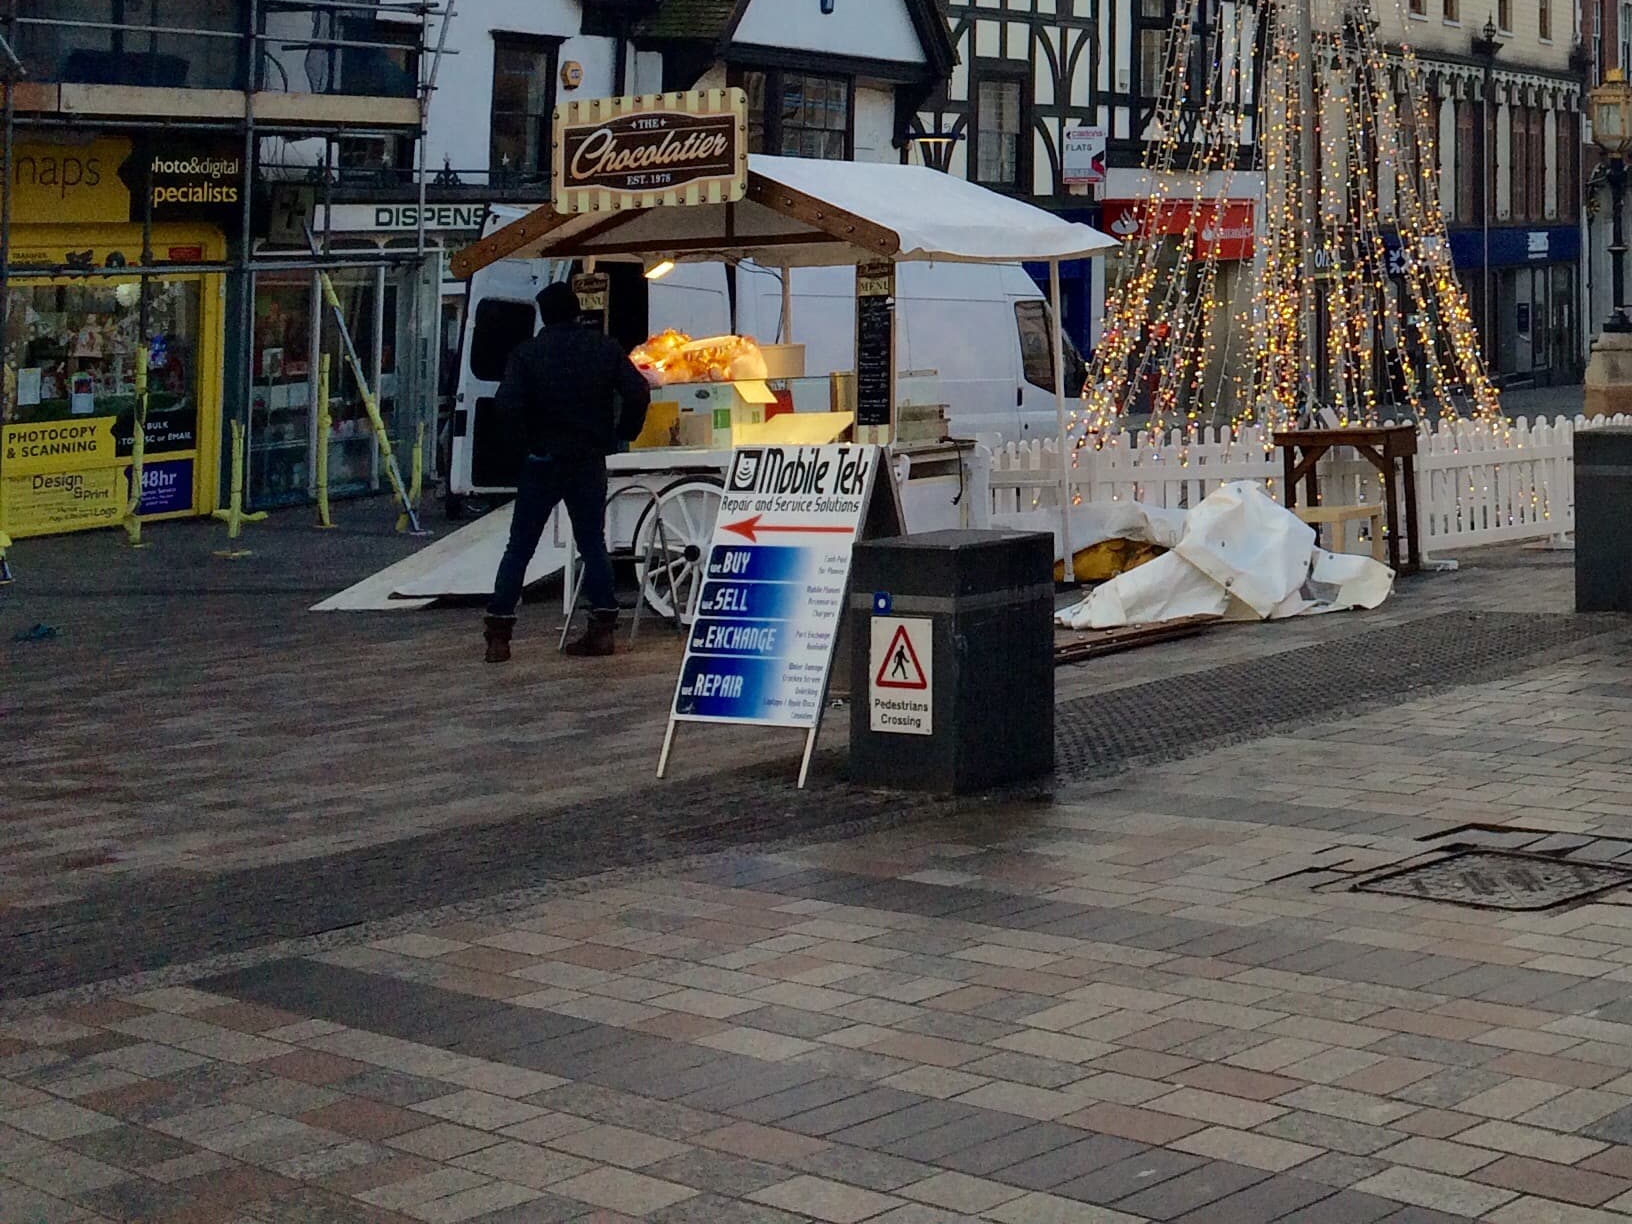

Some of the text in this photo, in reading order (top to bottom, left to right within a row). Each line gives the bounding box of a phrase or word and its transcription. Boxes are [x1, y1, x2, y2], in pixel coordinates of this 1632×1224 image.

[639, 118, 660, 129] THE
[571, 128, 728, 180] Chocolatier
[0, 156, 100, 199] naps
[626, 175, 649, 186] EST.
[150, 181, 238, 208] pecialists
[8, 425, 98, 445] PHOTOCOPY
[6, 440, 97, 460] & SCANNING
[758, 447, 869, 496] Mobile Tek
[33, 473, 84, 492] Design
[721, 495, 860, 514] Repair and Service Solutions
[723, 551, 752, 574] BUY
[713, 587, 748, 611] SELL
[705, 625, 777, 653] EXCHANGE
[694, 672, 744, 698] REPAIR
[874, 698, 929, 712] Pedestrians
[880, 713, 921, 729] Crossing
